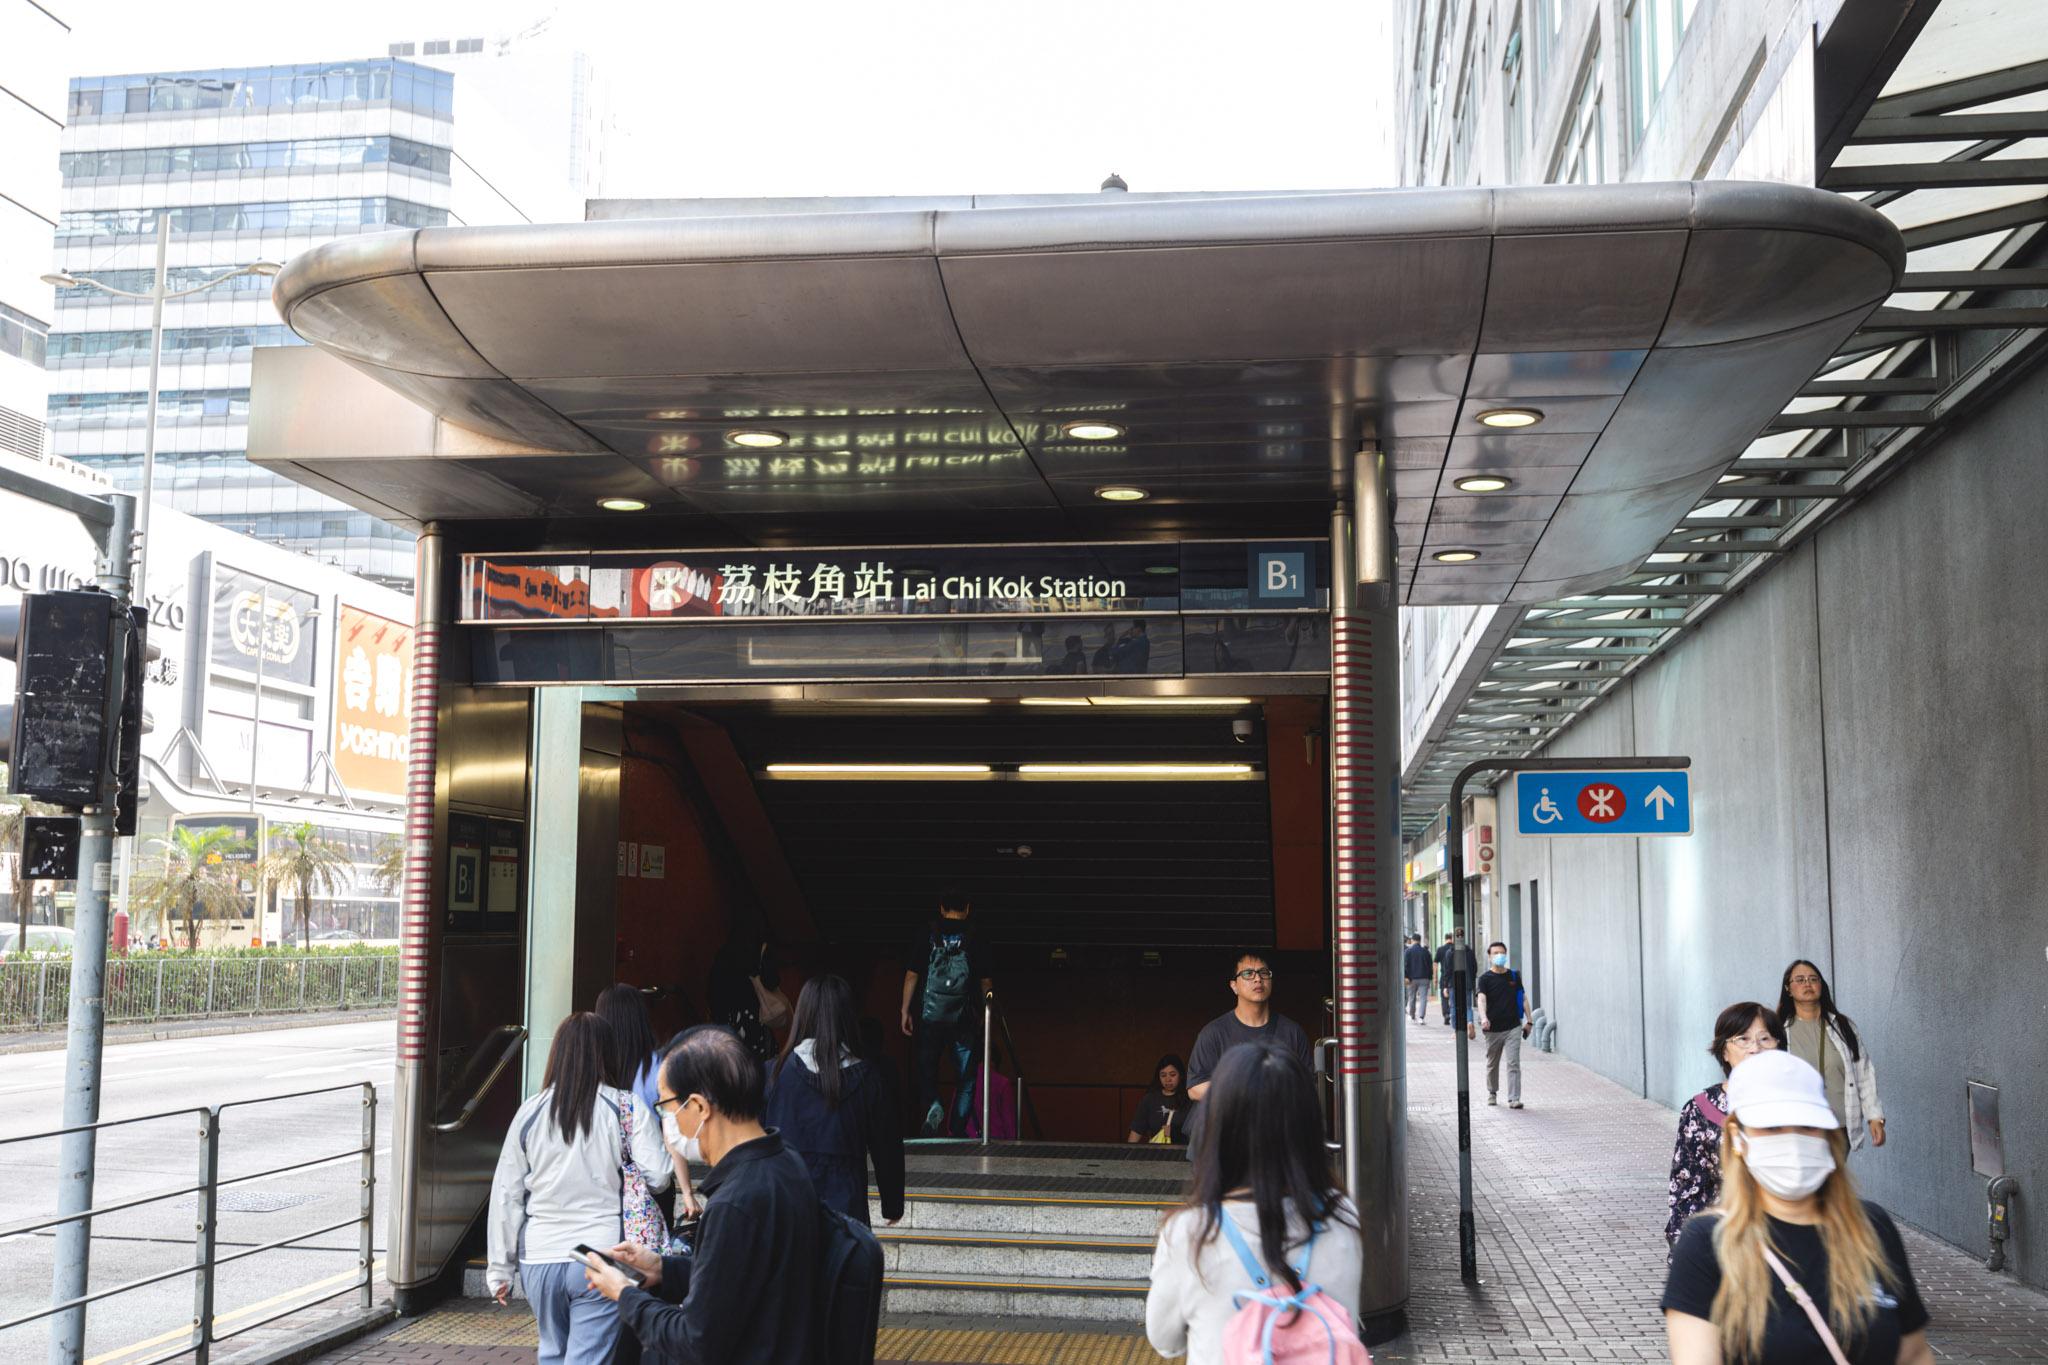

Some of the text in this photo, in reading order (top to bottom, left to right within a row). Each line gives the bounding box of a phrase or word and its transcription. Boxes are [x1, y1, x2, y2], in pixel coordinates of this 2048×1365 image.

[716, 562, 1126, 605] 荔枝角站 Lai Chi Kok Station
[1266, 560, 1298, 591] B1
